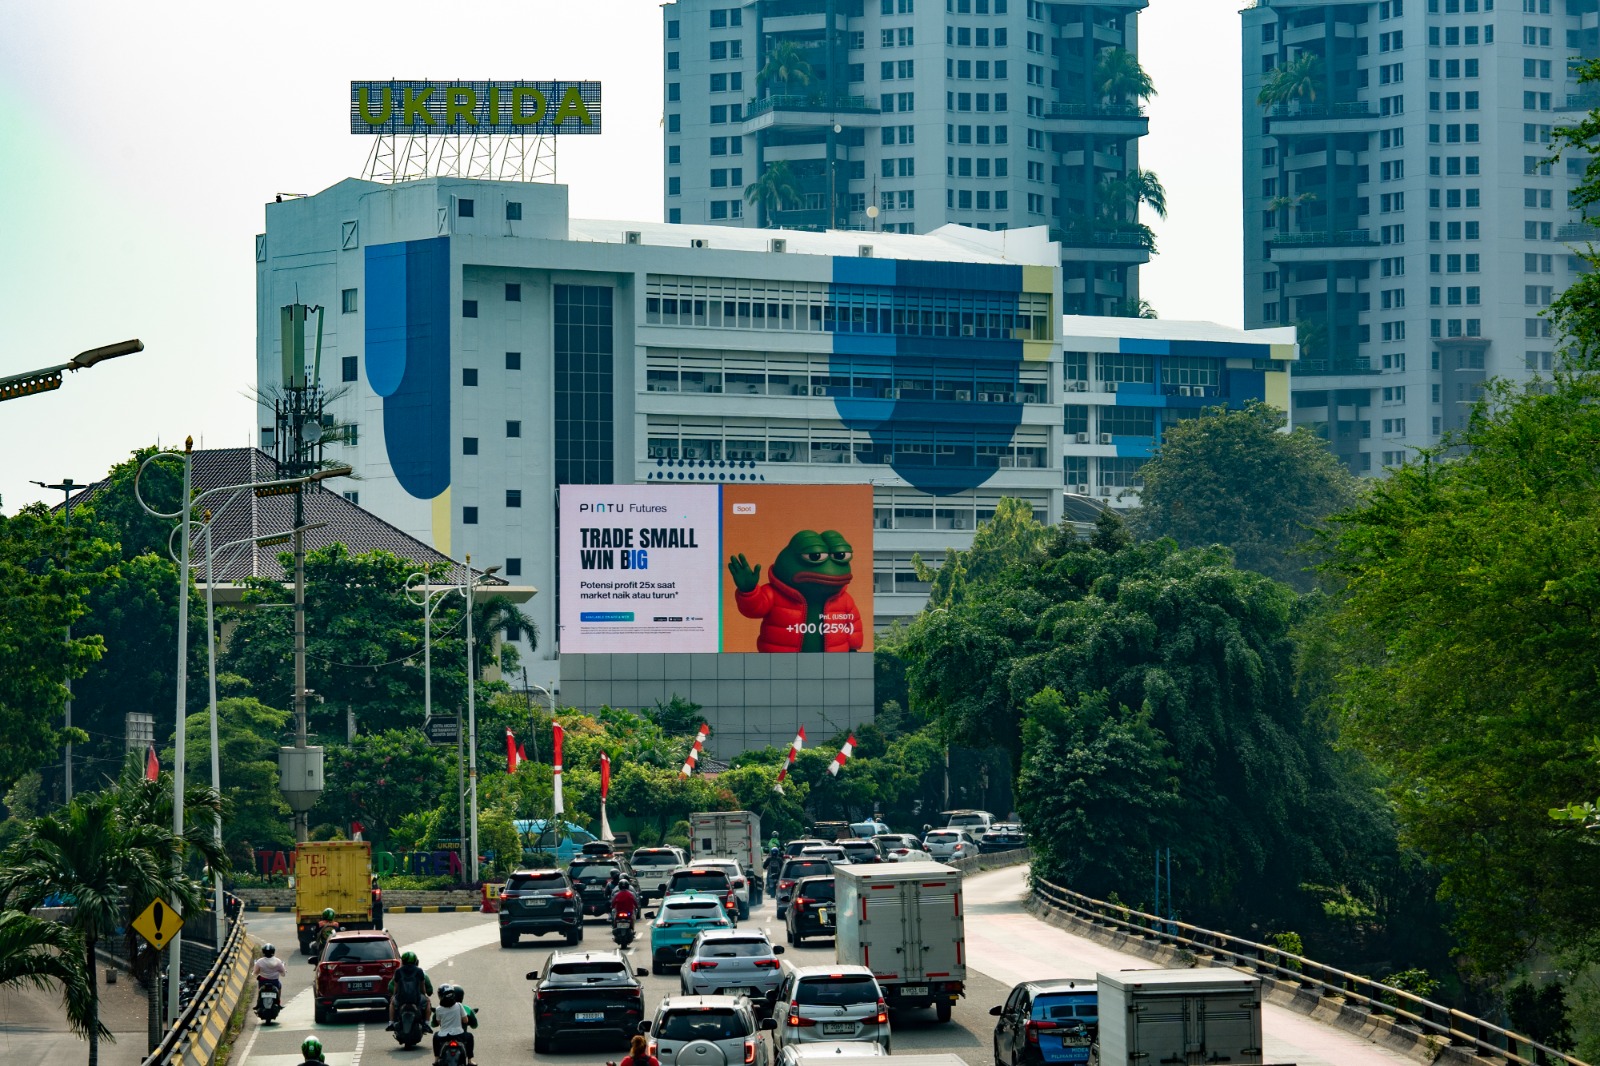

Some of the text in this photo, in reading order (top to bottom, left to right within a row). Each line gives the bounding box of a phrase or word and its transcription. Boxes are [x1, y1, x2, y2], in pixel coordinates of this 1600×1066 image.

[358, 86, 593, 126] UKRIDA
[580, 503, 668, 513] PINTU Futures
[580, 528, 698, 548] TRADE SMALL
[580, 549, 648, 570] WIN BIG
[580, 581, 613, 589] Potensi
[614, 581, 638, 590] profit
[786, 622, 854, 635] +100 (25%)
[310, 866, 327, 876] 02
[378, 851, 462, 876] DUREN
